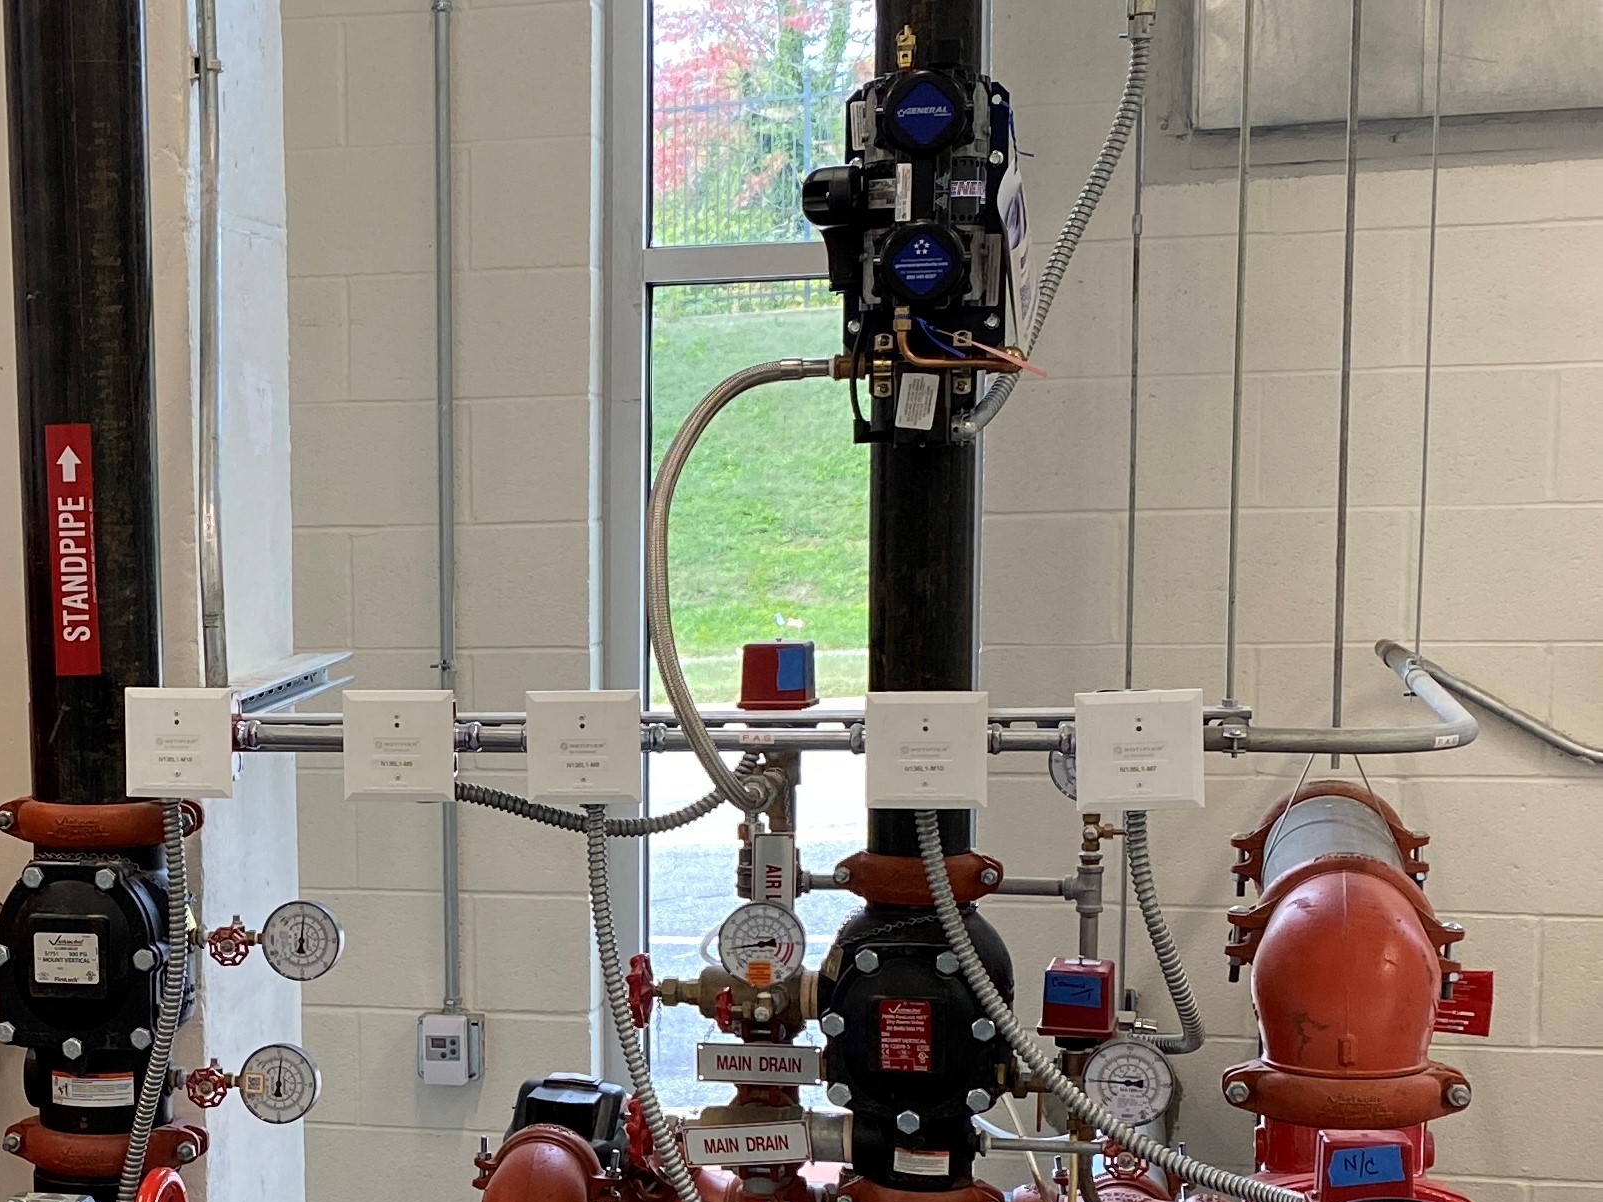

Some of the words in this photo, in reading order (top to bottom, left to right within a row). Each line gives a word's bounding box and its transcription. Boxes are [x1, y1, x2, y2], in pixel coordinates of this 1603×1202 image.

[904, 106, 947, 115] GENERAL
[56, 495, 91, 643] STANDPIPE
[765, 864, 783, 889] AIR
[716, 1054, 752, 1071] MAIN
[759, 1055, 802, 1073] DRAIN
[704, 1137, 739, 1154] MAIN
[746, 1134, 789, 1152] DRAIN
[1343, 1151, 1379, 1178] N/C
